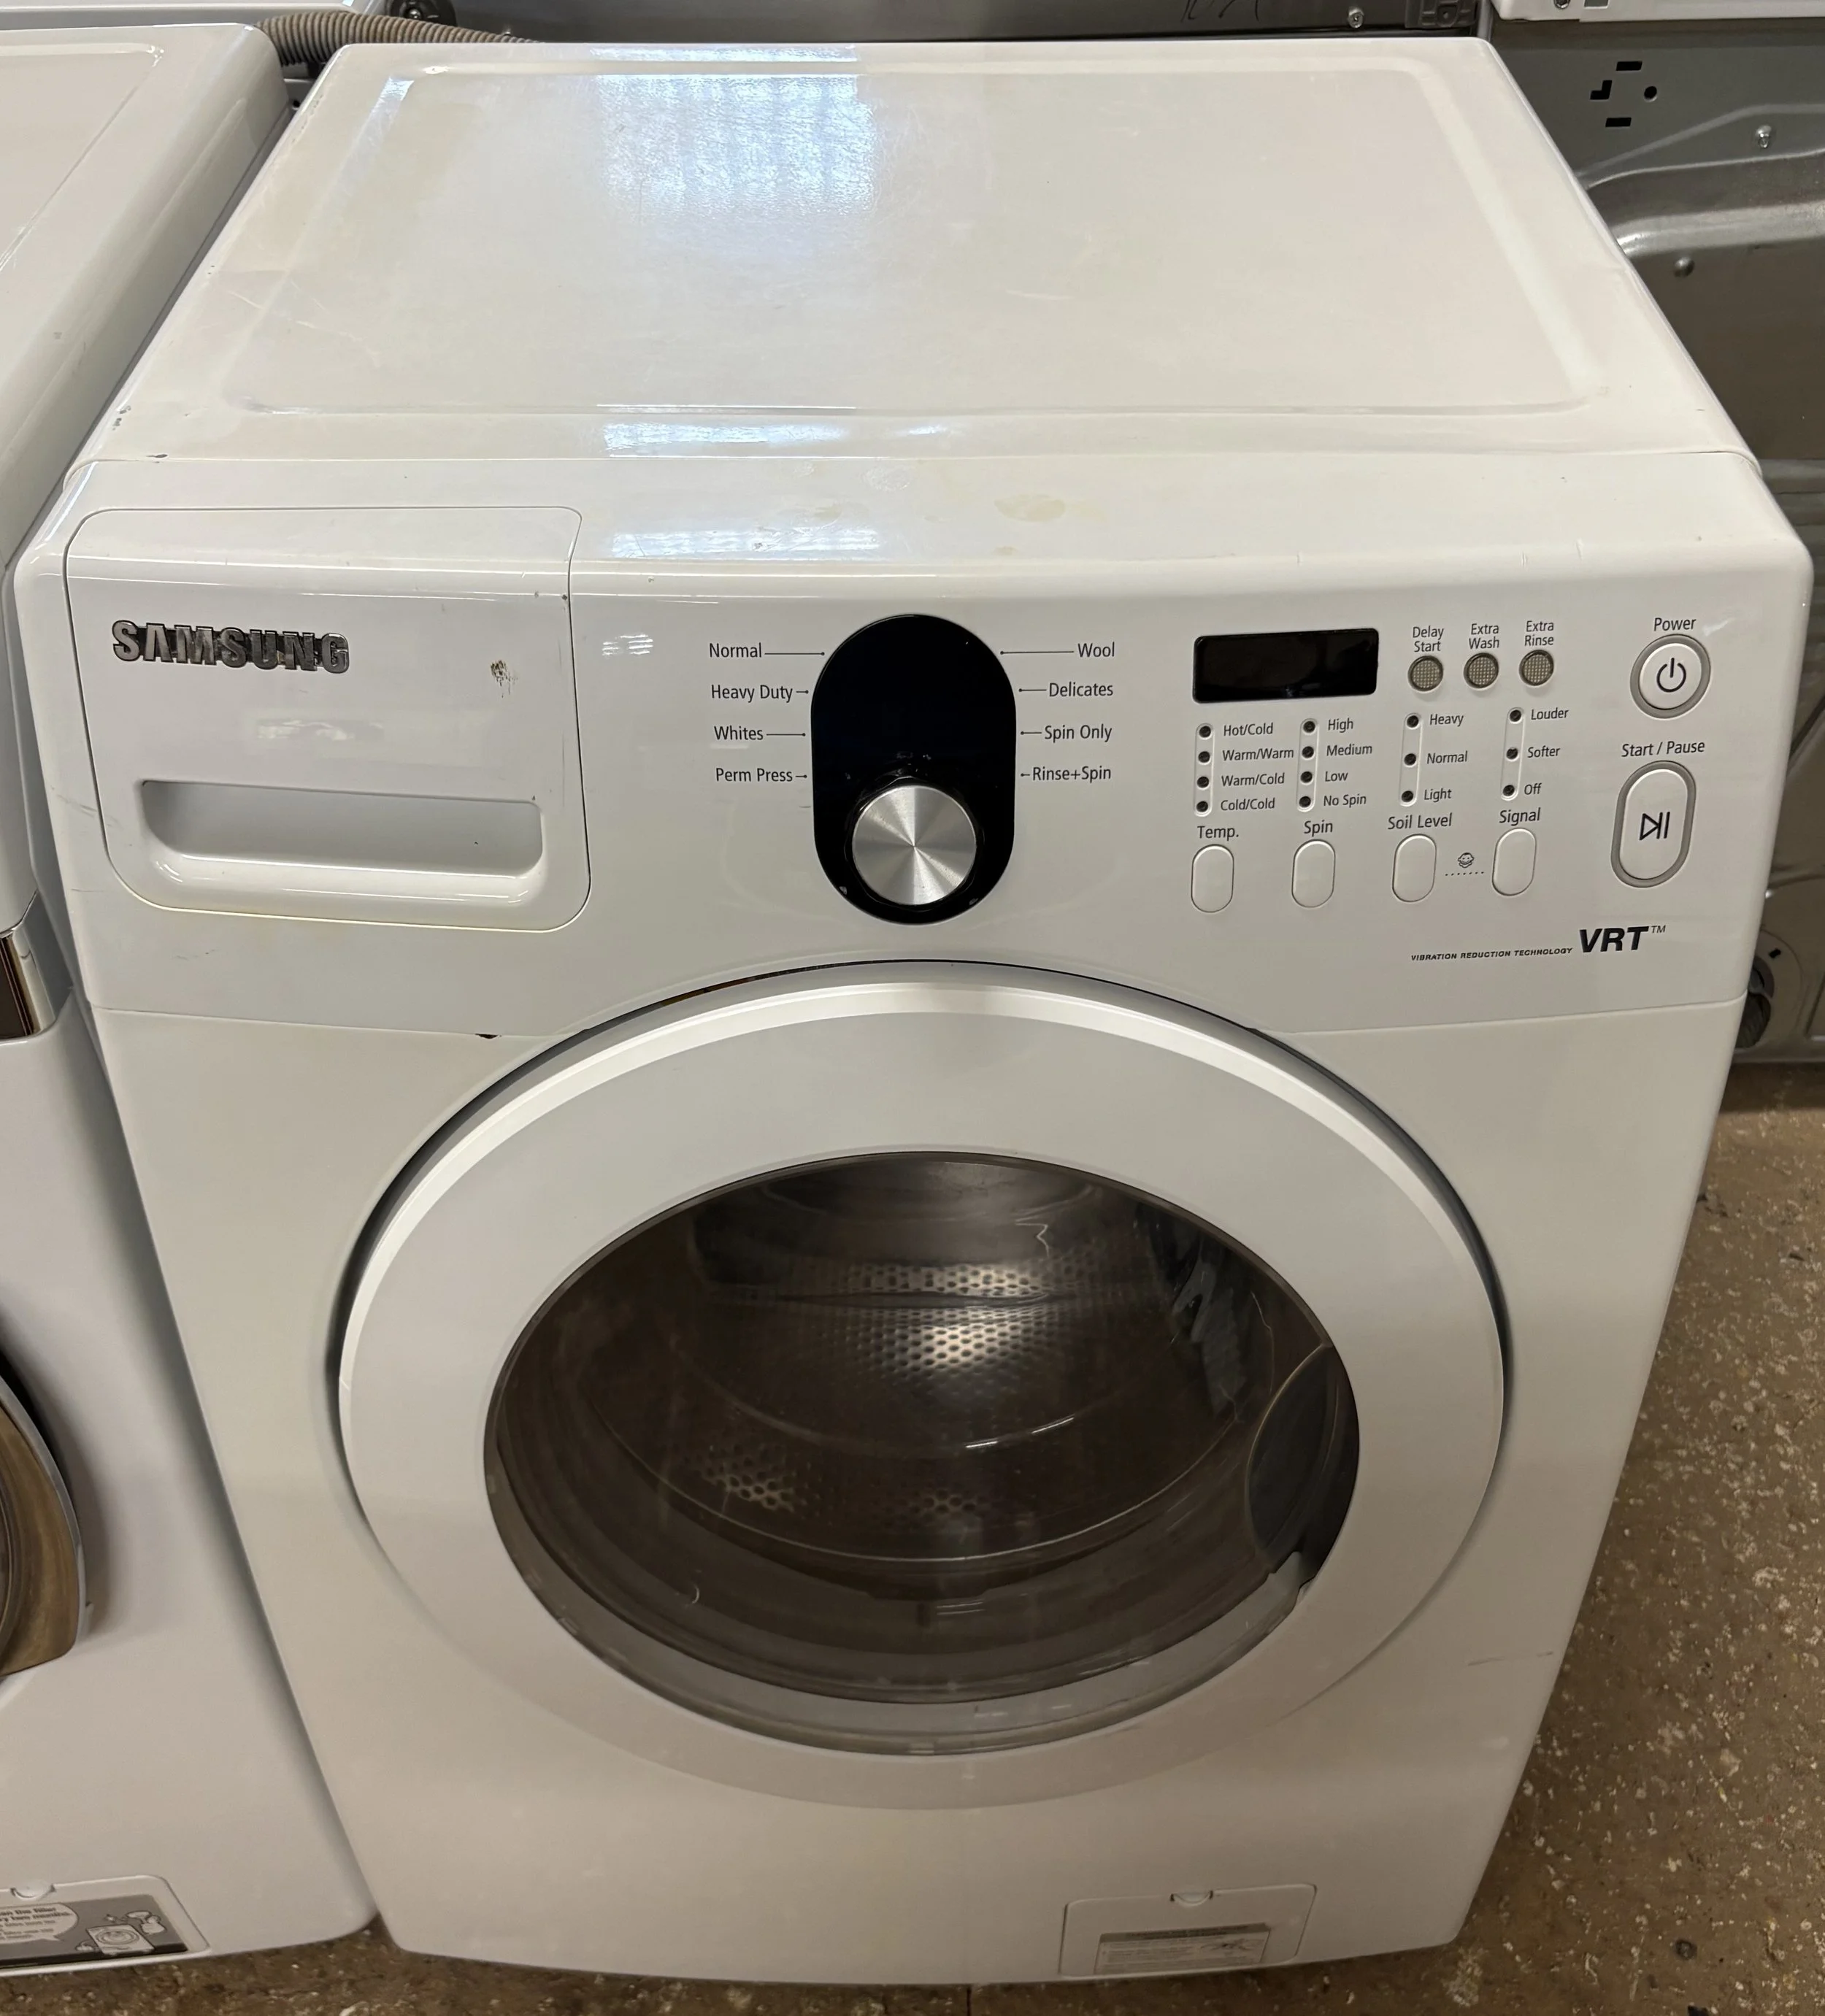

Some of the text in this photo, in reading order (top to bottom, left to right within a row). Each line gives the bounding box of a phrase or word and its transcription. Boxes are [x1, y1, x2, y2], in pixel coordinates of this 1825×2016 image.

[1470, 623, 1499, 635] Extra
[1526, 620, 1554, 633] Extra
[1653, 617, 1697, 632] Power
[1413, 625, 1445, 641] Delay
[1524, 634, 1554, 647] Rinse
[112, 619, 350, 674] SAMSUNG
[709, 642, 762, 658] Normal
[1077, 641, 1115, 658] Wool
[1413, 638, 1442, 653] Start
[1468, 636, 1500, 650] Wash
[711, 684, 794, 704] Heavy Duty
[1049, 681, 1114, 697] Delicates
[1429, 713, 1464, 728] Heavy
[1531, 707, 1570, 720] Louder
[713, 725, 764, 741] Whites
[1044, 723, 1113, 743] Spin Only
[1223, 722, 1274, 736] Hot/Cold
[1328, 717, 1354, 734] High
[1222, 747, 1294, 761] Warm/Warm
[1326, 743, 1373, 757] Medium
[1527, 745, 1561, 758] Softer
[1621, 743, 1654, 758] Start
[1666, 740, 1705, 755] Pause
[1426, 750, 1468, 765] Normal
[715, 767, 793, 782] Perm Press
[1032, 765, 1112, 783] Rinse+Spin
[1221, 772, 1286, 787] Warm/Cold
[1324, 770, 1349, 782] Low
[1424, 788, 1453, 803] Light
[1524, 782, 1542, 796] Off
[1220, 796, 1276, 811] Cold/Cold
[1323, 793, 1367, 809] No Spin
[1387, 812, 1453, 830] Soil Level
[1499, 807, 1541, 826] Signal
[1196, 825, 1240, 842] Temp.
[1303, 819, 1333, 837] Spin
[1411, 953, 1457, 961] VIBRATION
[1460, 950, 1511, 959] REDUCTION
[1513, 947, 1573, 957] TECHNOLOGY
